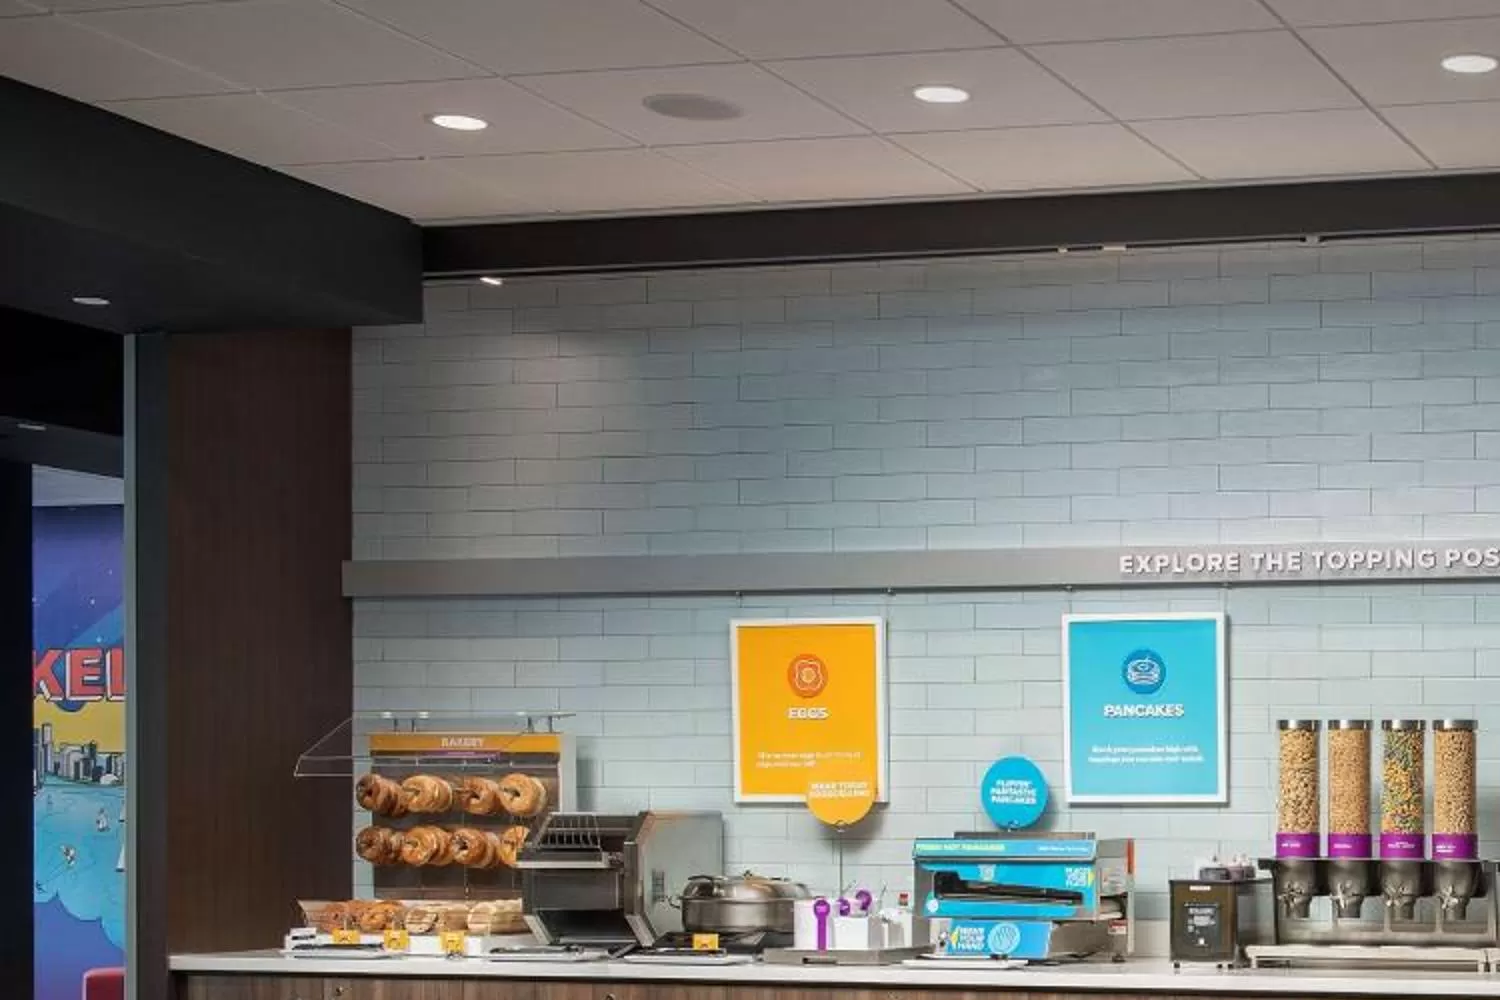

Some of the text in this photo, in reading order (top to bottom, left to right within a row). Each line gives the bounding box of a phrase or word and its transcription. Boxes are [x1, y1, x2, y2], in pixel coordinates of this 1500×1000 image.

[1119, 552, 1241, 574] EXPLORE
[1250, 551, 1302, 572] THE
[1312, 549, 1438, 571] TOPPING
[788, 706, 830, 720] EGGS
[1103, 704, 1185, 717] PANCAKES
